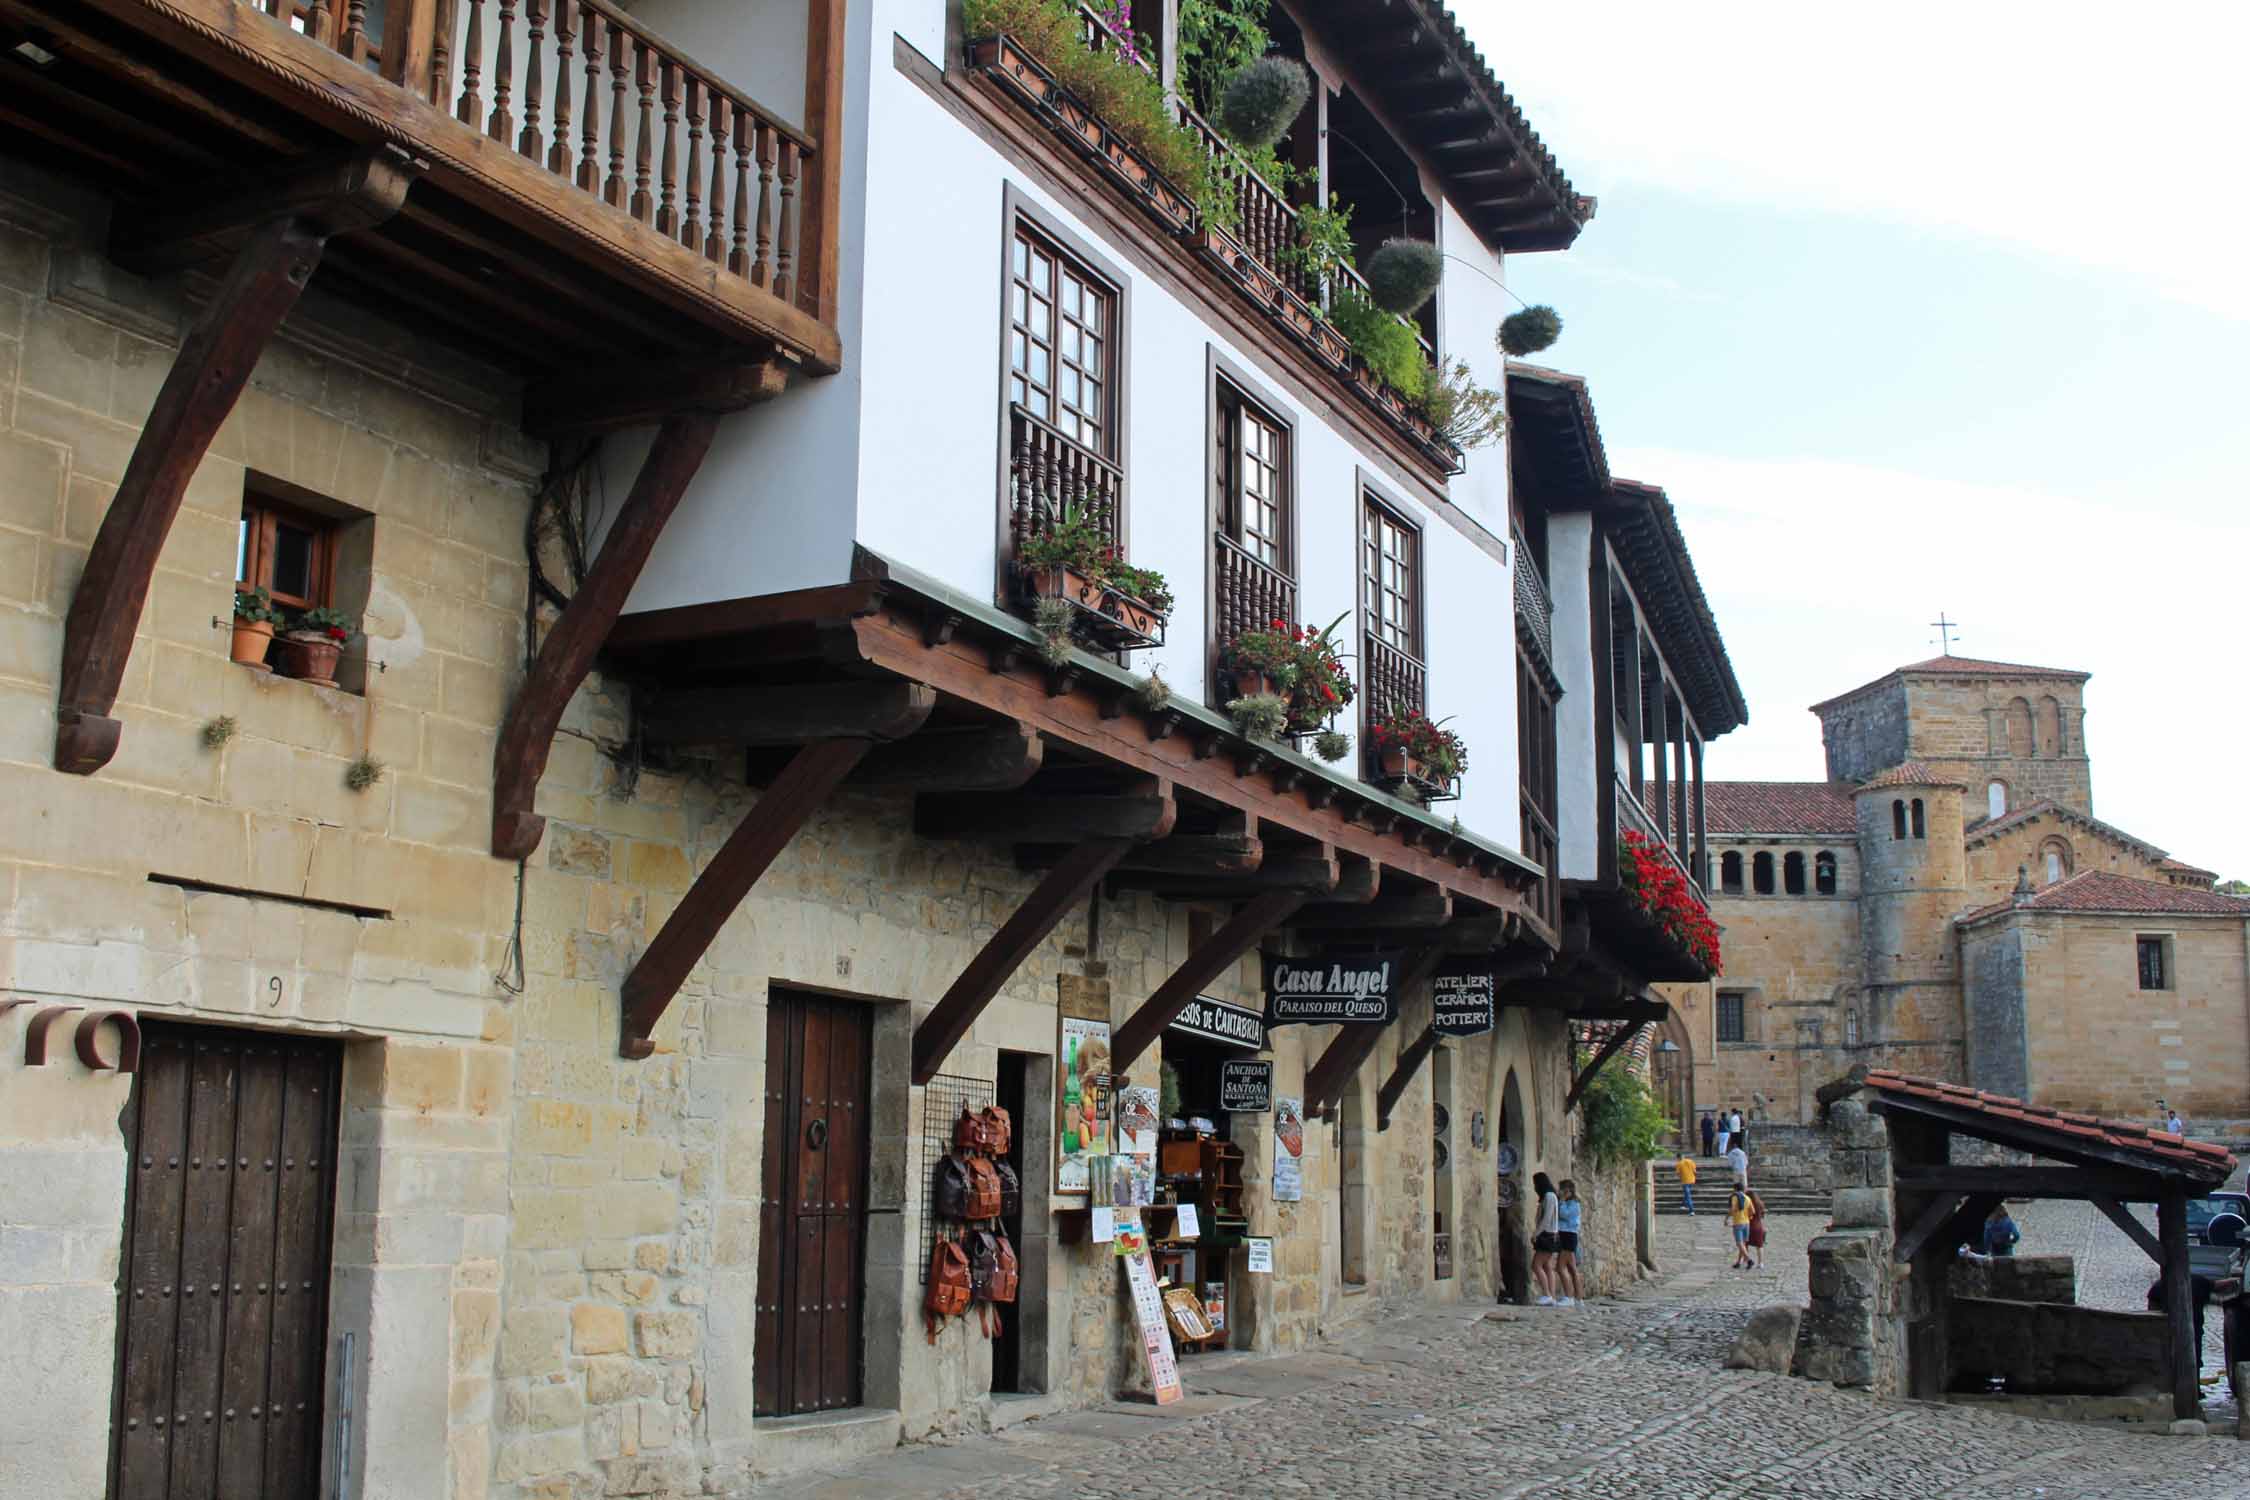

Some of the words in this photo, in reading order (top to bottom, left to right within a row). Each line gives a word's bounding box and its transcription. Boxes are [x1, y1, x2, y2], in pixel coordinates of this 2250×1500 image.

[1274, 964, 1324, 993] Casa
[1326, 961, 1390, 1001] Angel
[1434, 974, 1489, 989] ATELIER
[269, 976, 282, 1008] 9
[1280, 1000, 1322, 1014] PARAISO
[1323, 1001, 1344, 1014] DEL
[1345, 1000, 1383, 1017] QUESO
[1175, 1002, 1201, 1026] ESOS
[1203, 1010, 1213, 1030] DE
[1215, 1007, 1260, 1043] CANTABRIA
[1435, 1012, 1489, 1027] POTTERY
[1226, 1064, 1268, 1076] ANCHOAS
[1225, 1081, 1268, 1096] SANTOÑA
